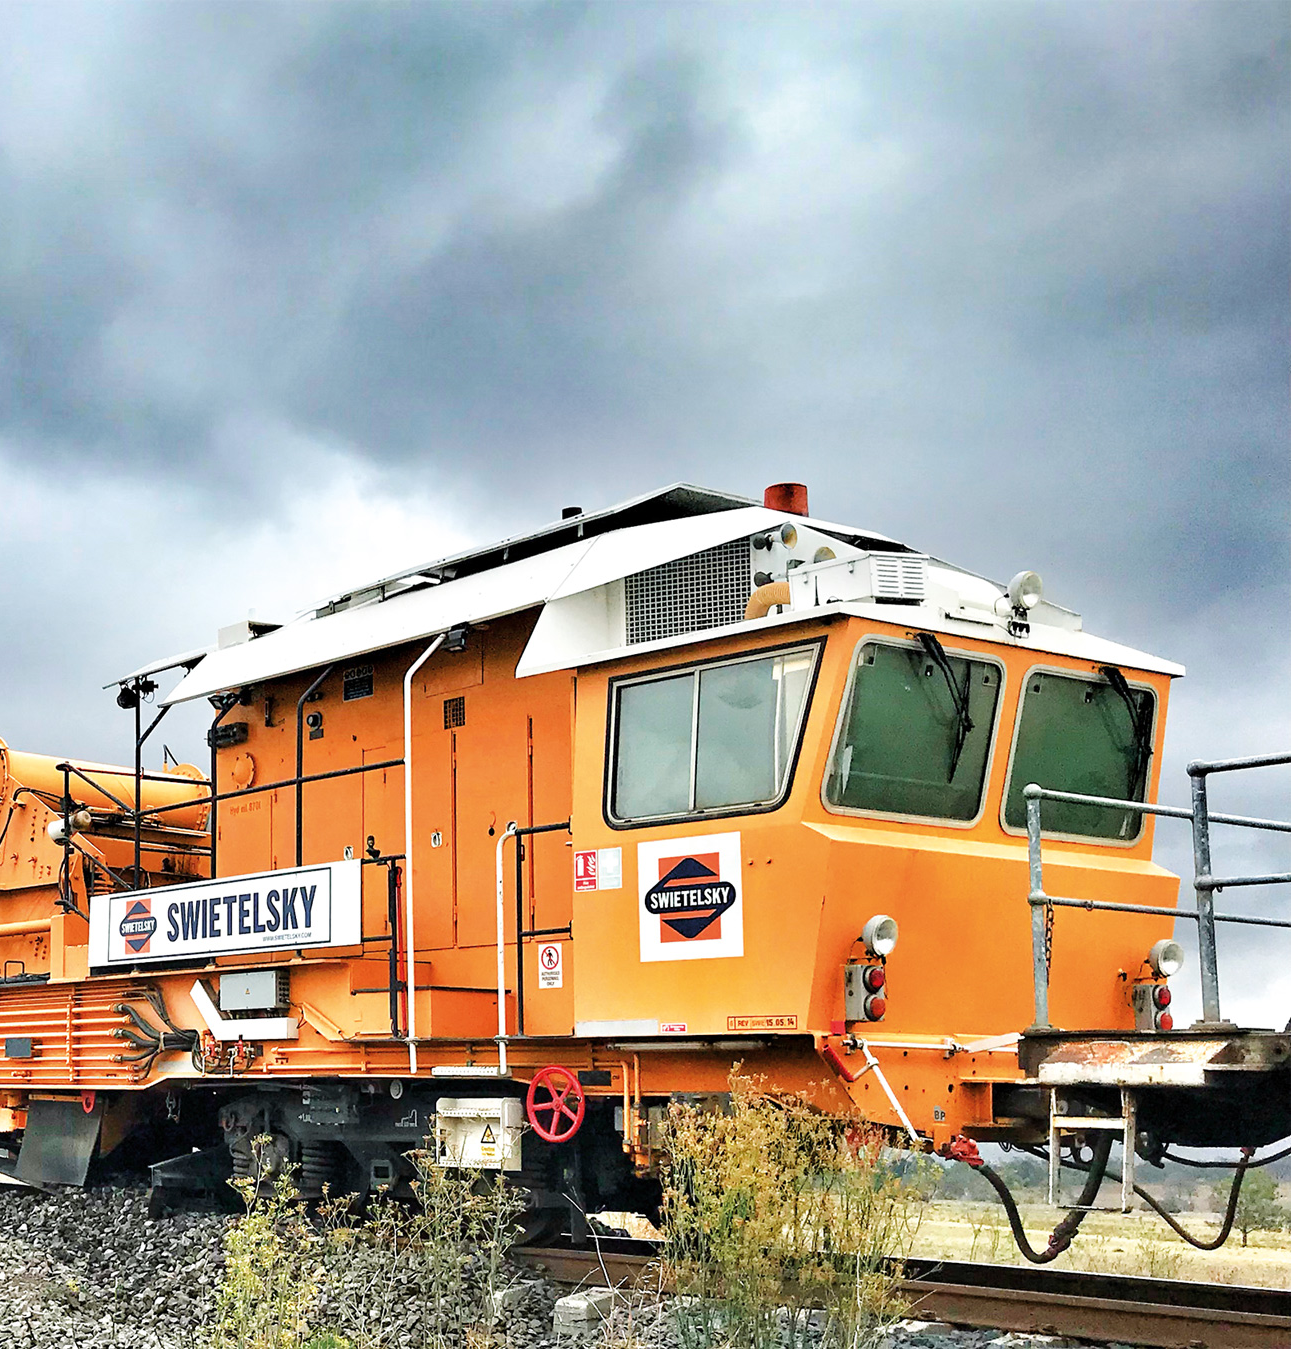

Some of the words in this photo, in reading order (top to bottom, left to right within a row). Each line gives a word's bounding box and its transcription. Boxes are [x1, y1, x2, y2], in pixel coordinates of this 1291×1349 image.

[650, 886, 730, 910] SWIETELSKY
[167, 885, 318, 943] SWIETELSKY
[121, 919, 156, 935] SWIETELSKY
[934, 1110, 946, 1121] BP
